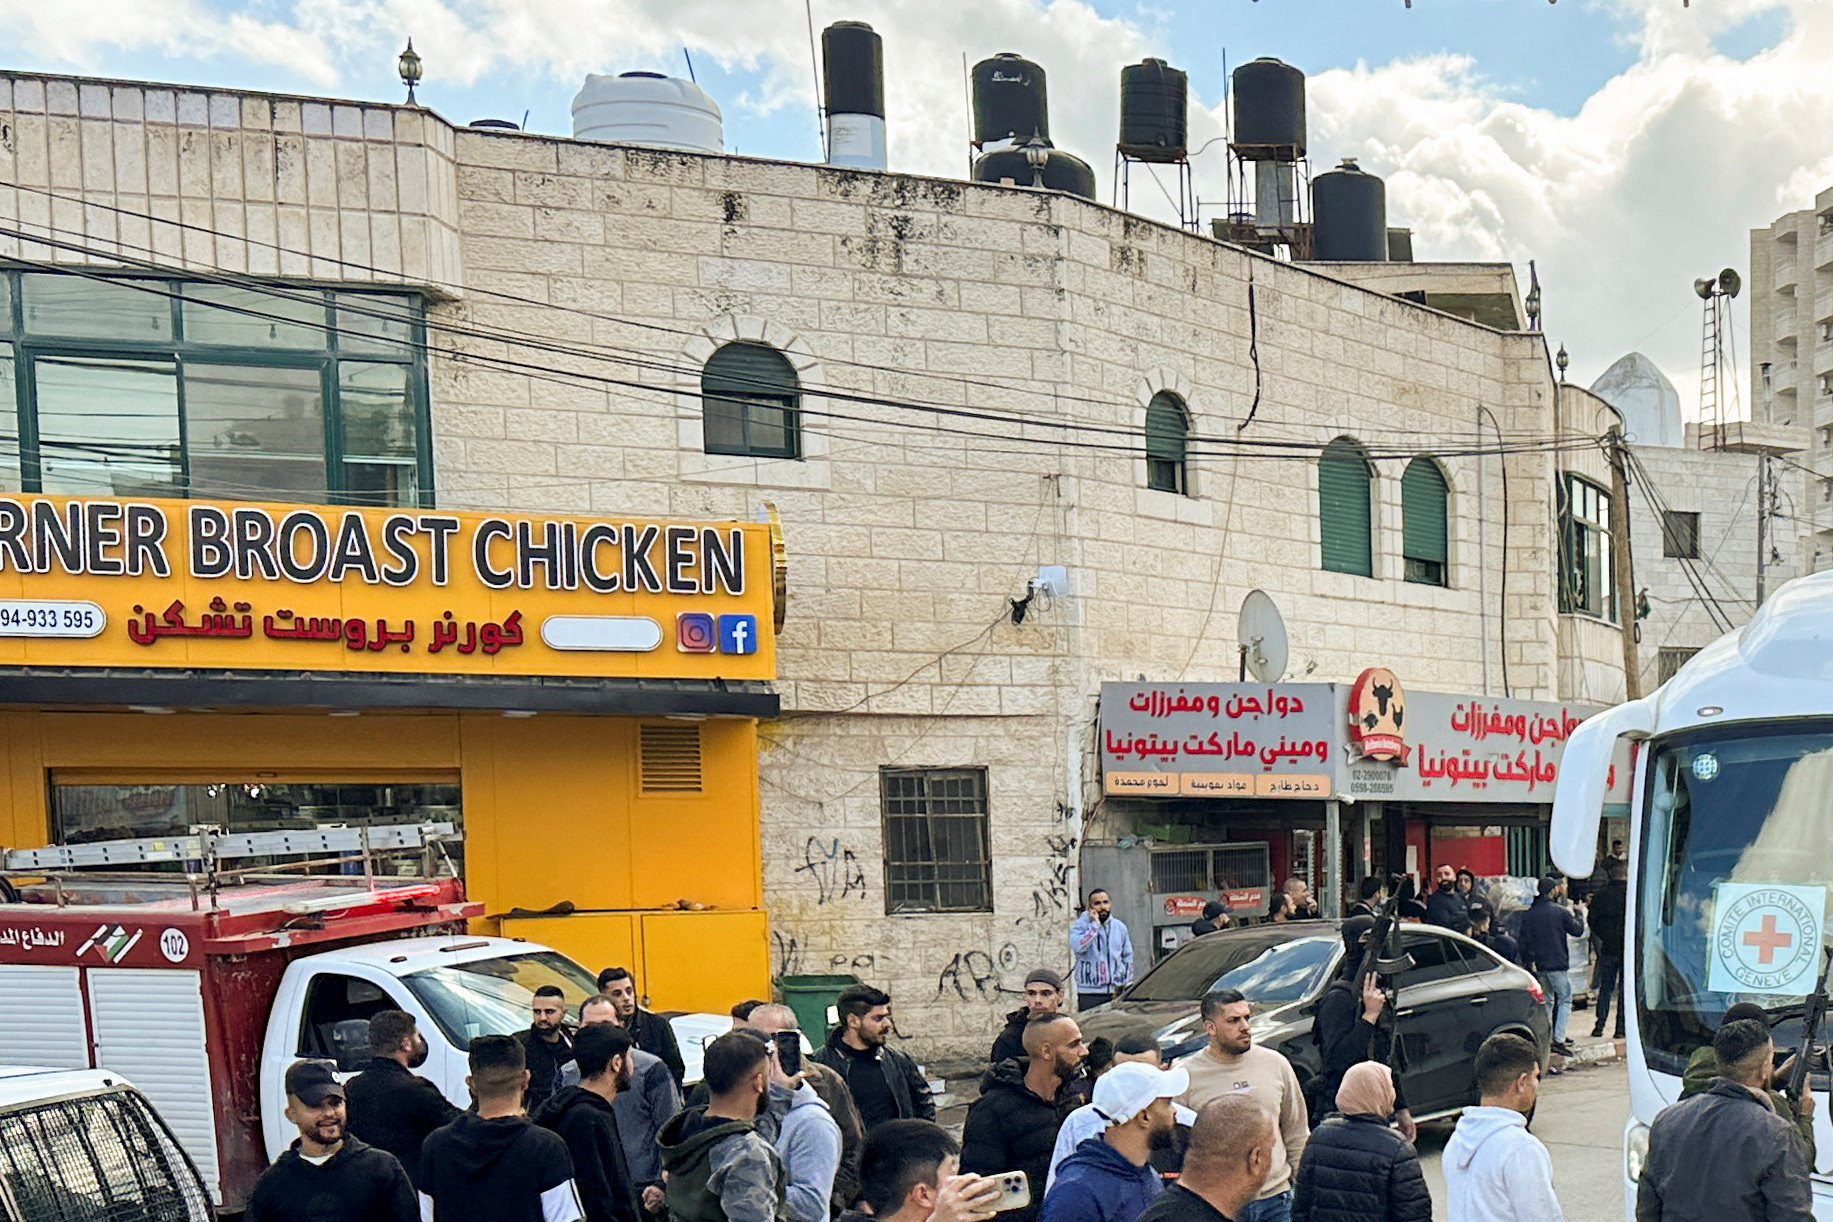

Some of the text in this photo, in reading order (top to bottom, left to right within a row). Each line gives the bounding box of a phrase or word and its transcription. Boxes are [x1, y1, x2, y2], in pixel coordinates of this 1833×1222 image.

[188, 506, 460, 587] BROAST
[472, 518, 745, 596] CHICKEN
[63, 610, 93, 629] 595
[127, 596, 524, 654] كورنر بروست تشكن
[1129, 688, 1304, 720] دواجن ومفرزات
[1451, 700, 1585, 748] واجن ومفرزات
[1105, 728, 1179, 763] بيتونيا
[1182, 731, 1256, 761] ماركت
[1259, 735, 1329, 772] وميني
[1418, 743, 1490, 788] بيتونيا
[1493, 749, 1556, 793] ماركت
[22, 927, 65, 950] الدفاع
[163, 934, 186, 956] 102
[1720, 892, 1815, 964] COMITE INTERNATIONAL
[1735, 966, 1792, 987] GENEVE
